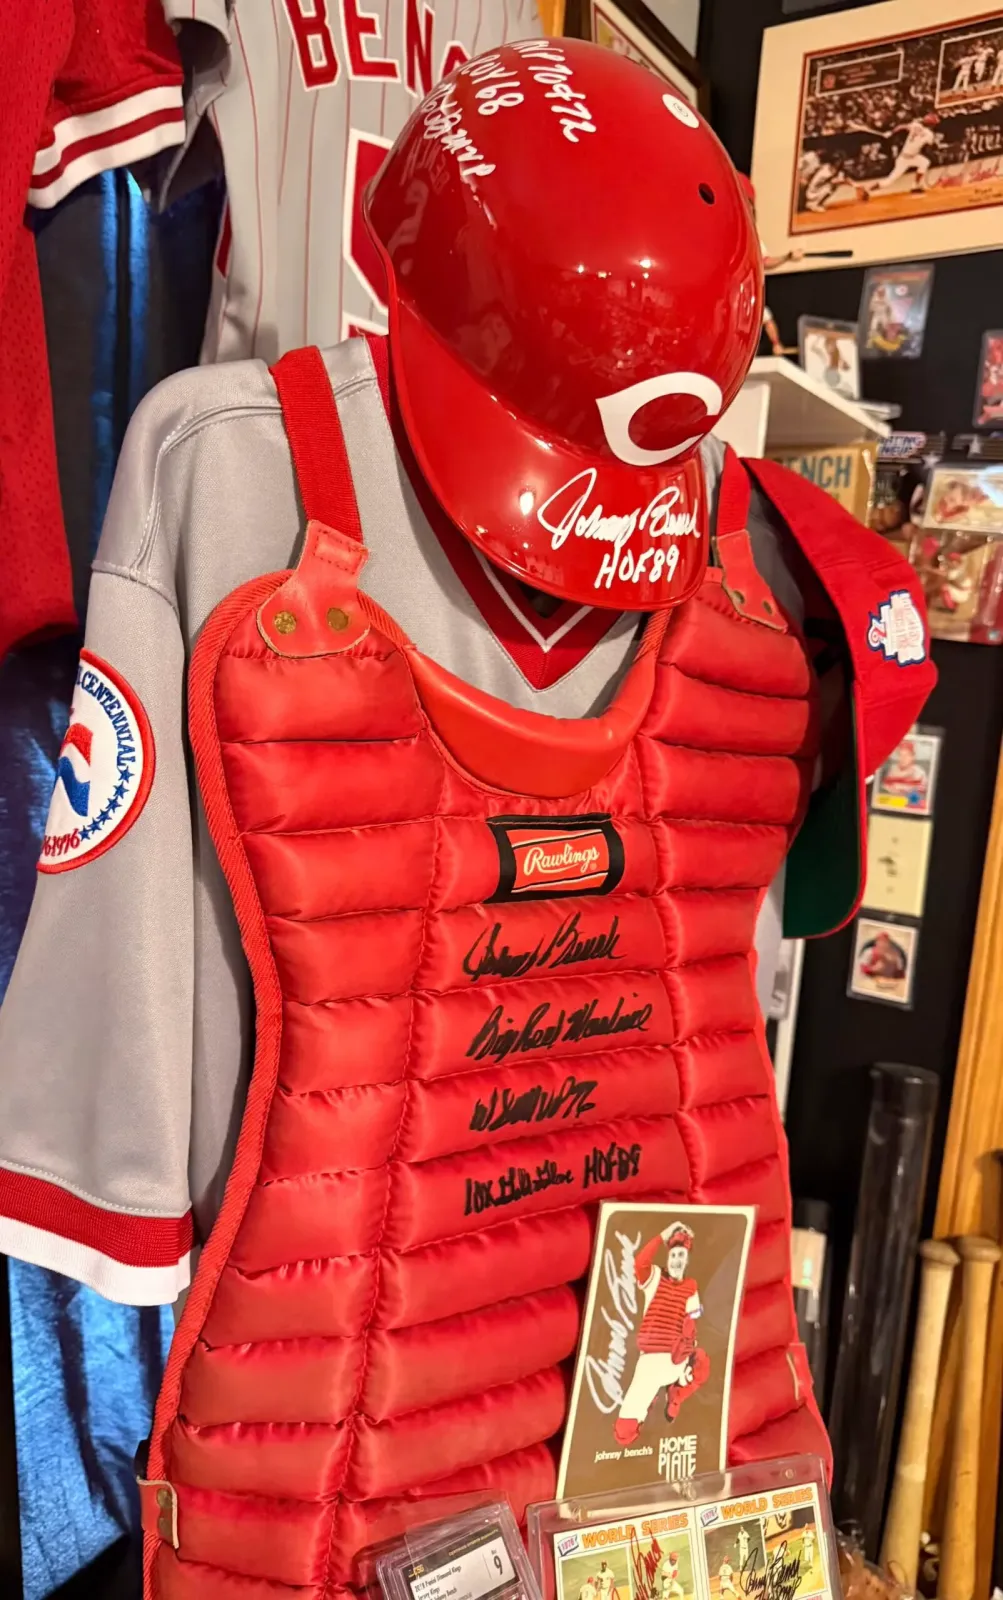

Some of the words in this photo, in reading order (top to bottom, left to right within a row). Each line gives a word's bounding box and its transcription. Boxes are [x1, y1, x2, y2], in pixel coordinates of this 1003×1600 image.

[537, 468, 640, 550] Johnny
[524, 843, 599, 876] Rawlings
[594, 1450, 621, 1463] johnny
[624, 1446, 653, 1457] bench's
[659, 1434, 697, 1453] HOME
[721, 1497, 768, 1520] WORLD
[772, 1487, 813, 1508] SERIES
[582, 1524, 635, 1549] WORLD
[641, 1513, 689, 1536] SERIES
[494, 1555, 503, 1576] 9
